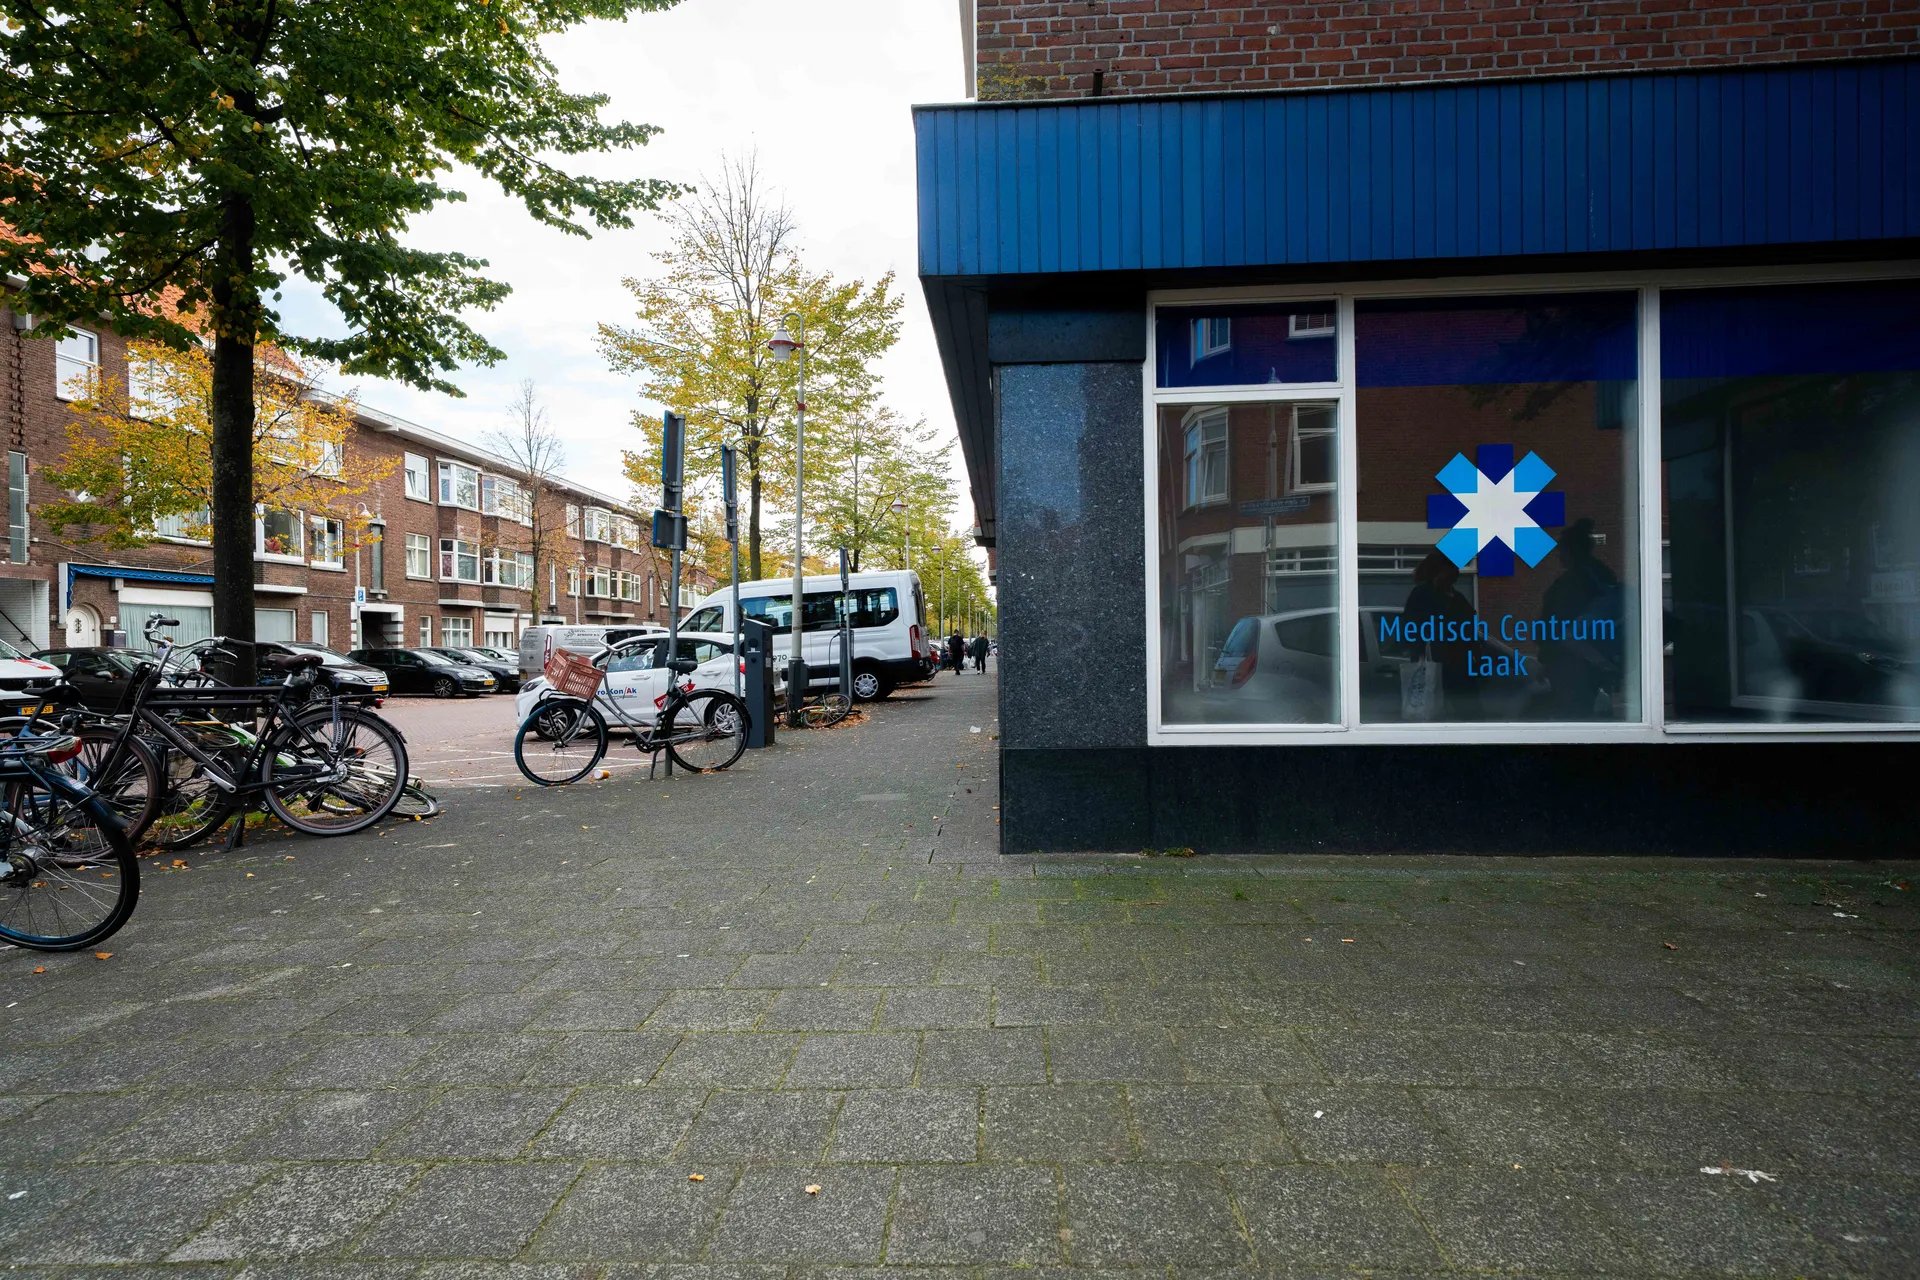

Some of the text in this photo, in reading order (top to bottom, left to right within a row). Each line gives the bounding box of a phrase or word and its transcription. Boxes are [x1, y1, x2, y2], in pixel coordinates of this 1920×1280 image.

[1379, 614, 1615, 642] Medisch Centrum
[1467, 648, 1528, 676] Laak
